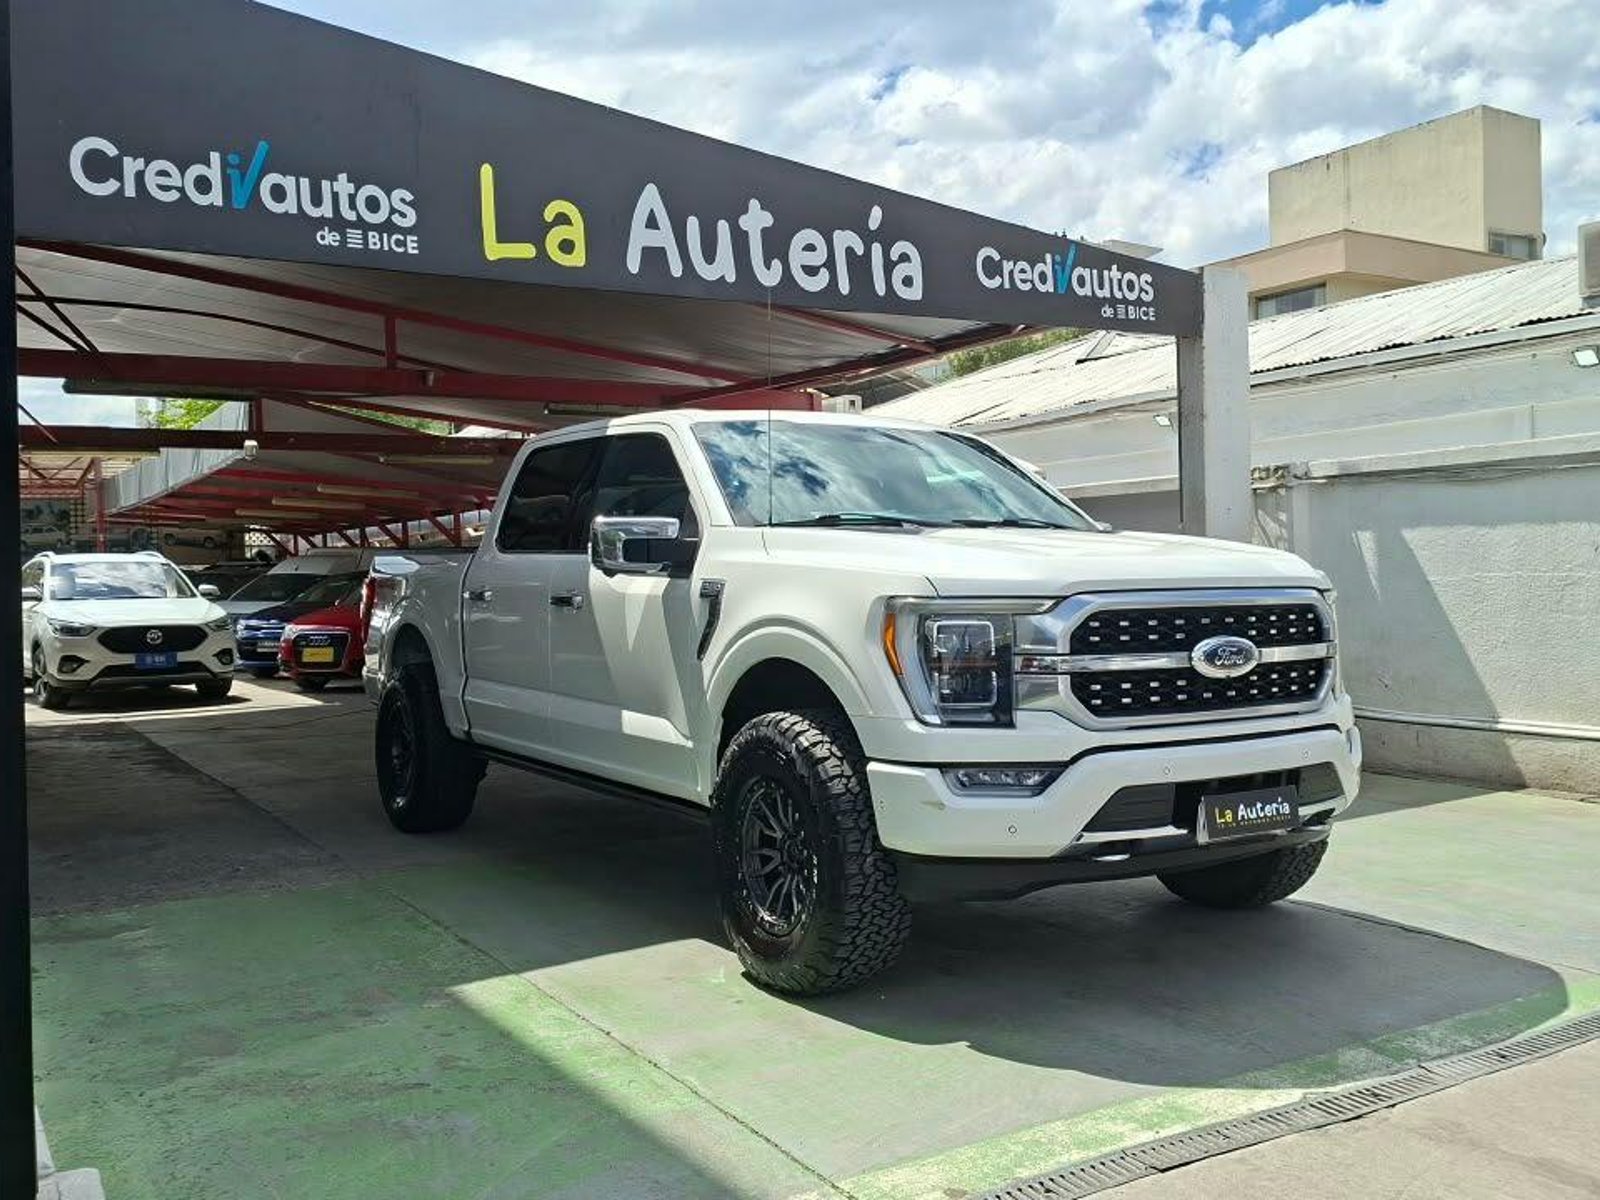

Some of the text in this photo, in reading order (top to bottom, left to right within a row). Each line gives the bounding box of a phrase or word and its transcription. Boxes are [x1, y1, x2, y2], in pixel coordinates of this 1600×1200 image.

[316, 226, 419, 254] de BICE
[480, 163, 924, 301] La Autería
[1101, 304, 1156, 321] de BICE
[1215, 647, 1246, 666] Ford
[1215, 806, 1233, 823] La
